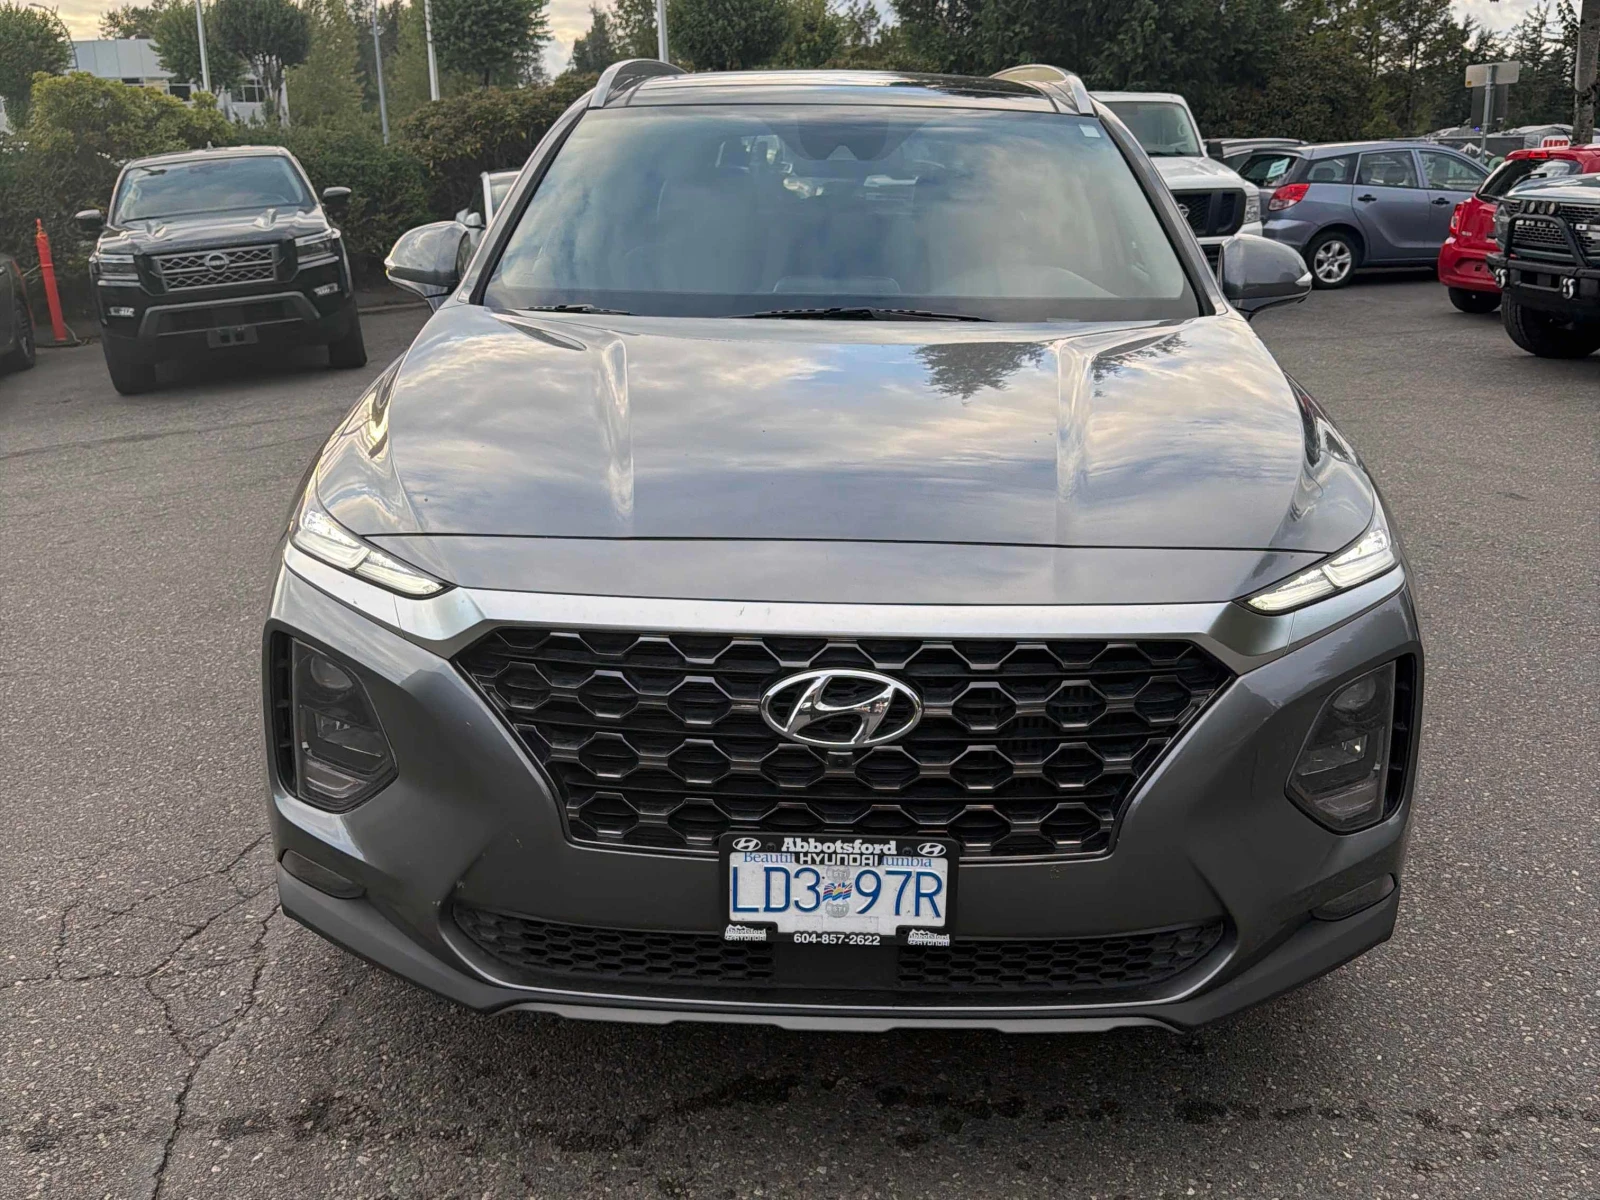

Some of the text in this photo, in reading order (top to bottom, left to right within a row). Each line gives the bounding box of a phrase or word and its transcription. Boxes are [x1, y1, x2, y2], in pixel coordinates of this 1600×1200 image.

[781, 837, 897, 855] Abbotsford
[800, 852, 878, 867] HYUNDAI
[732, 866, 942, 918] LD3 97R
[793, 933, 881, 946] 604-857-2622
